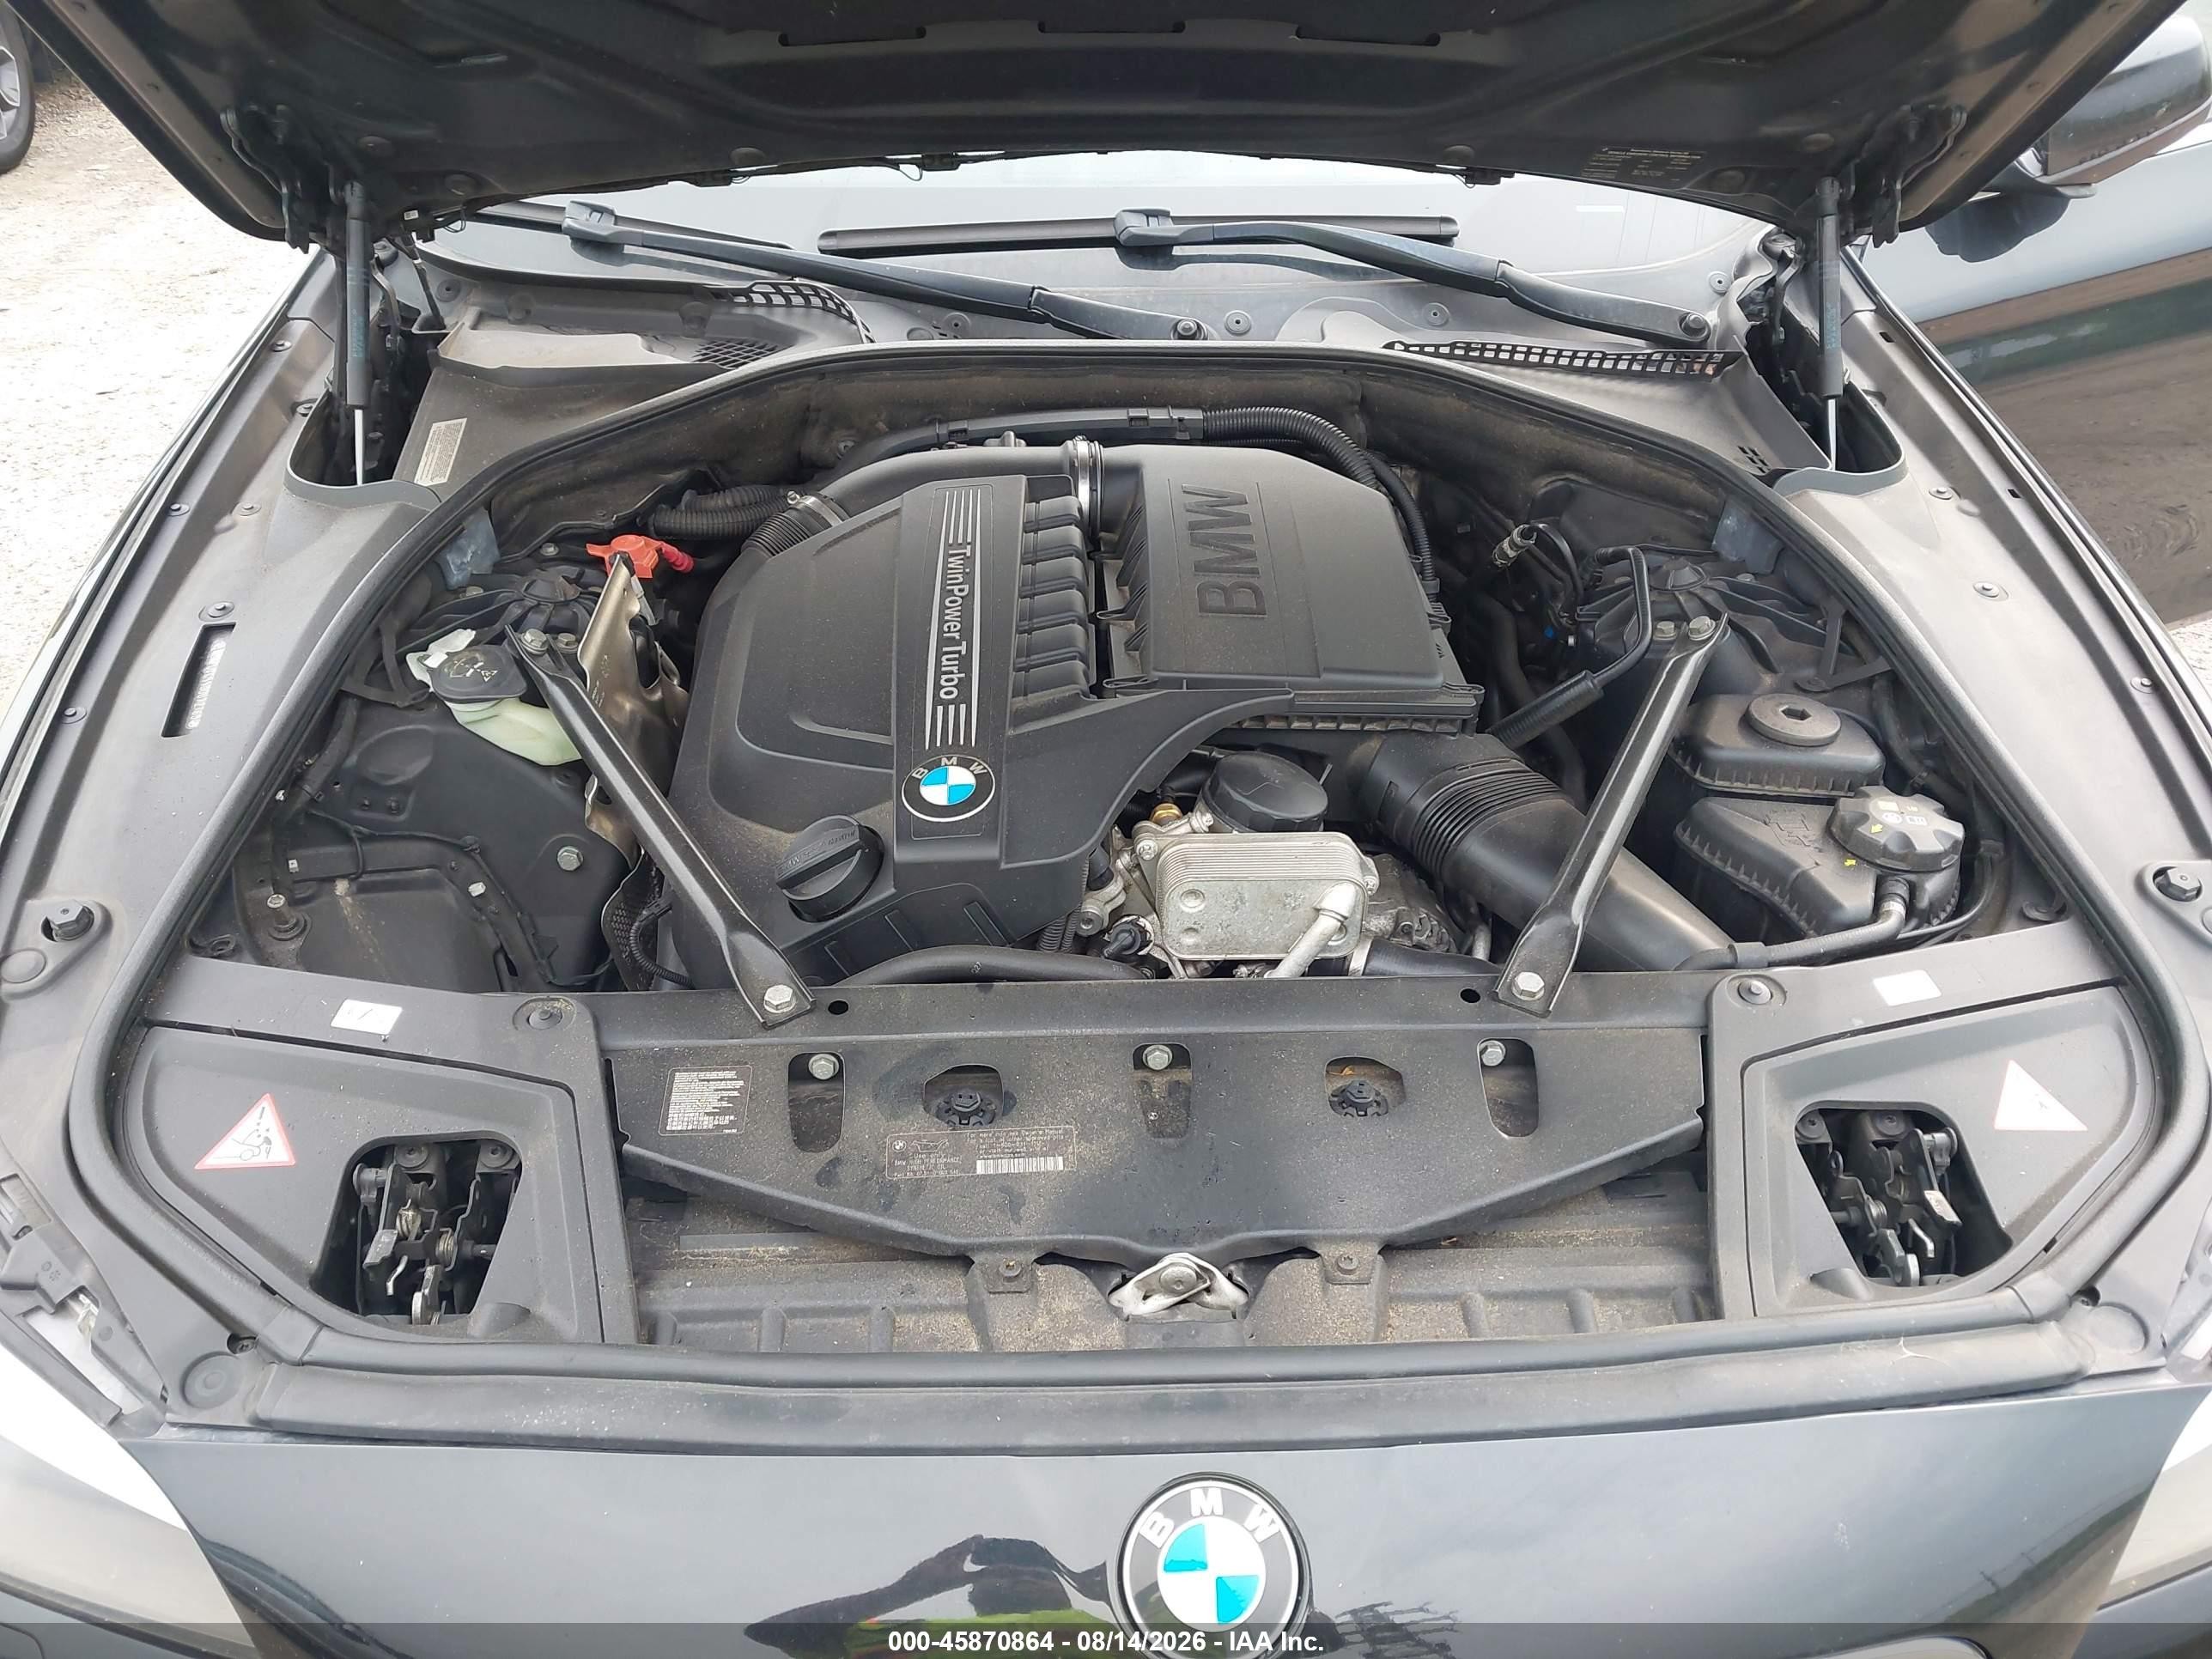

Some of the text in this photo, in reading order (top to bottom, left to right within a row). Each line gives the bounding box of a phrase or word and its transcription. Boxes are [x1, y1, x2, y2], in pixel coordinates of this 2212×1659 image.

[1182, 484, 1267, 618] BMW
[939, 545, 971, 700] TwinPower Turbo
[911, 757, 988, 779] BMW
[1139, 1488, 1280, 1548] BMW
